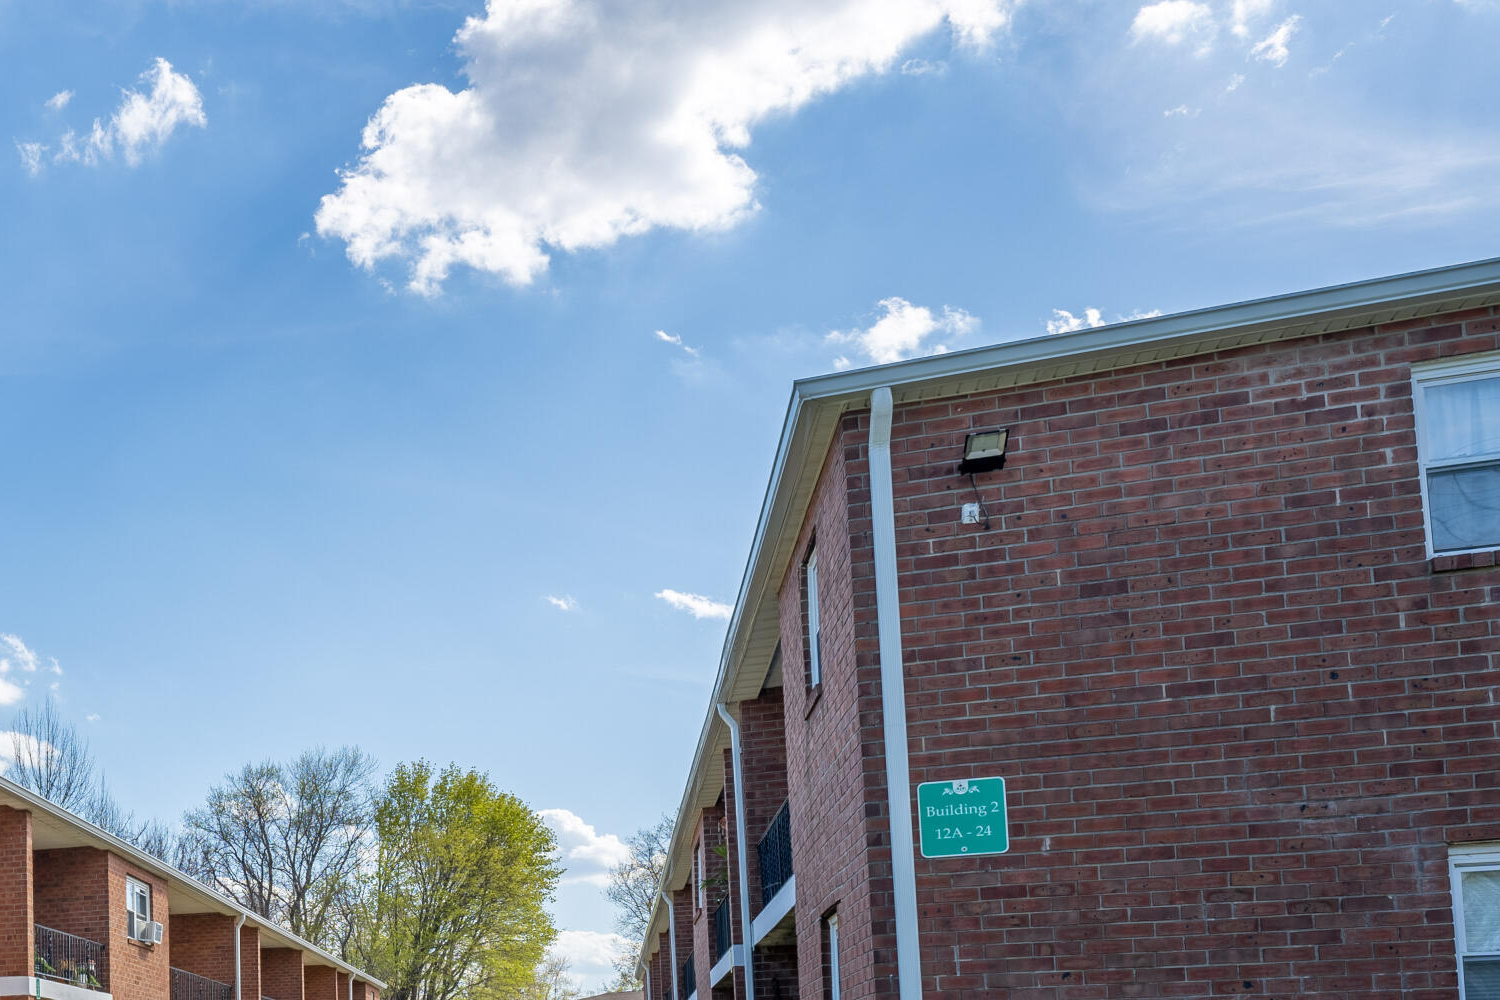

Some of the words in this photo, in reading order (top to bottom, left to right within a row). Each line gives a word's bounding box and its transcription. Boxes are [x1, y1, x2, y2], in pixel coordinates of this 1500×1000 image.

[926, 804, 987, 817] Building
[991, 801, 999, 812] 2
[935, 827, 963, 840] 12A
[975, 825, 992, 837] 24
